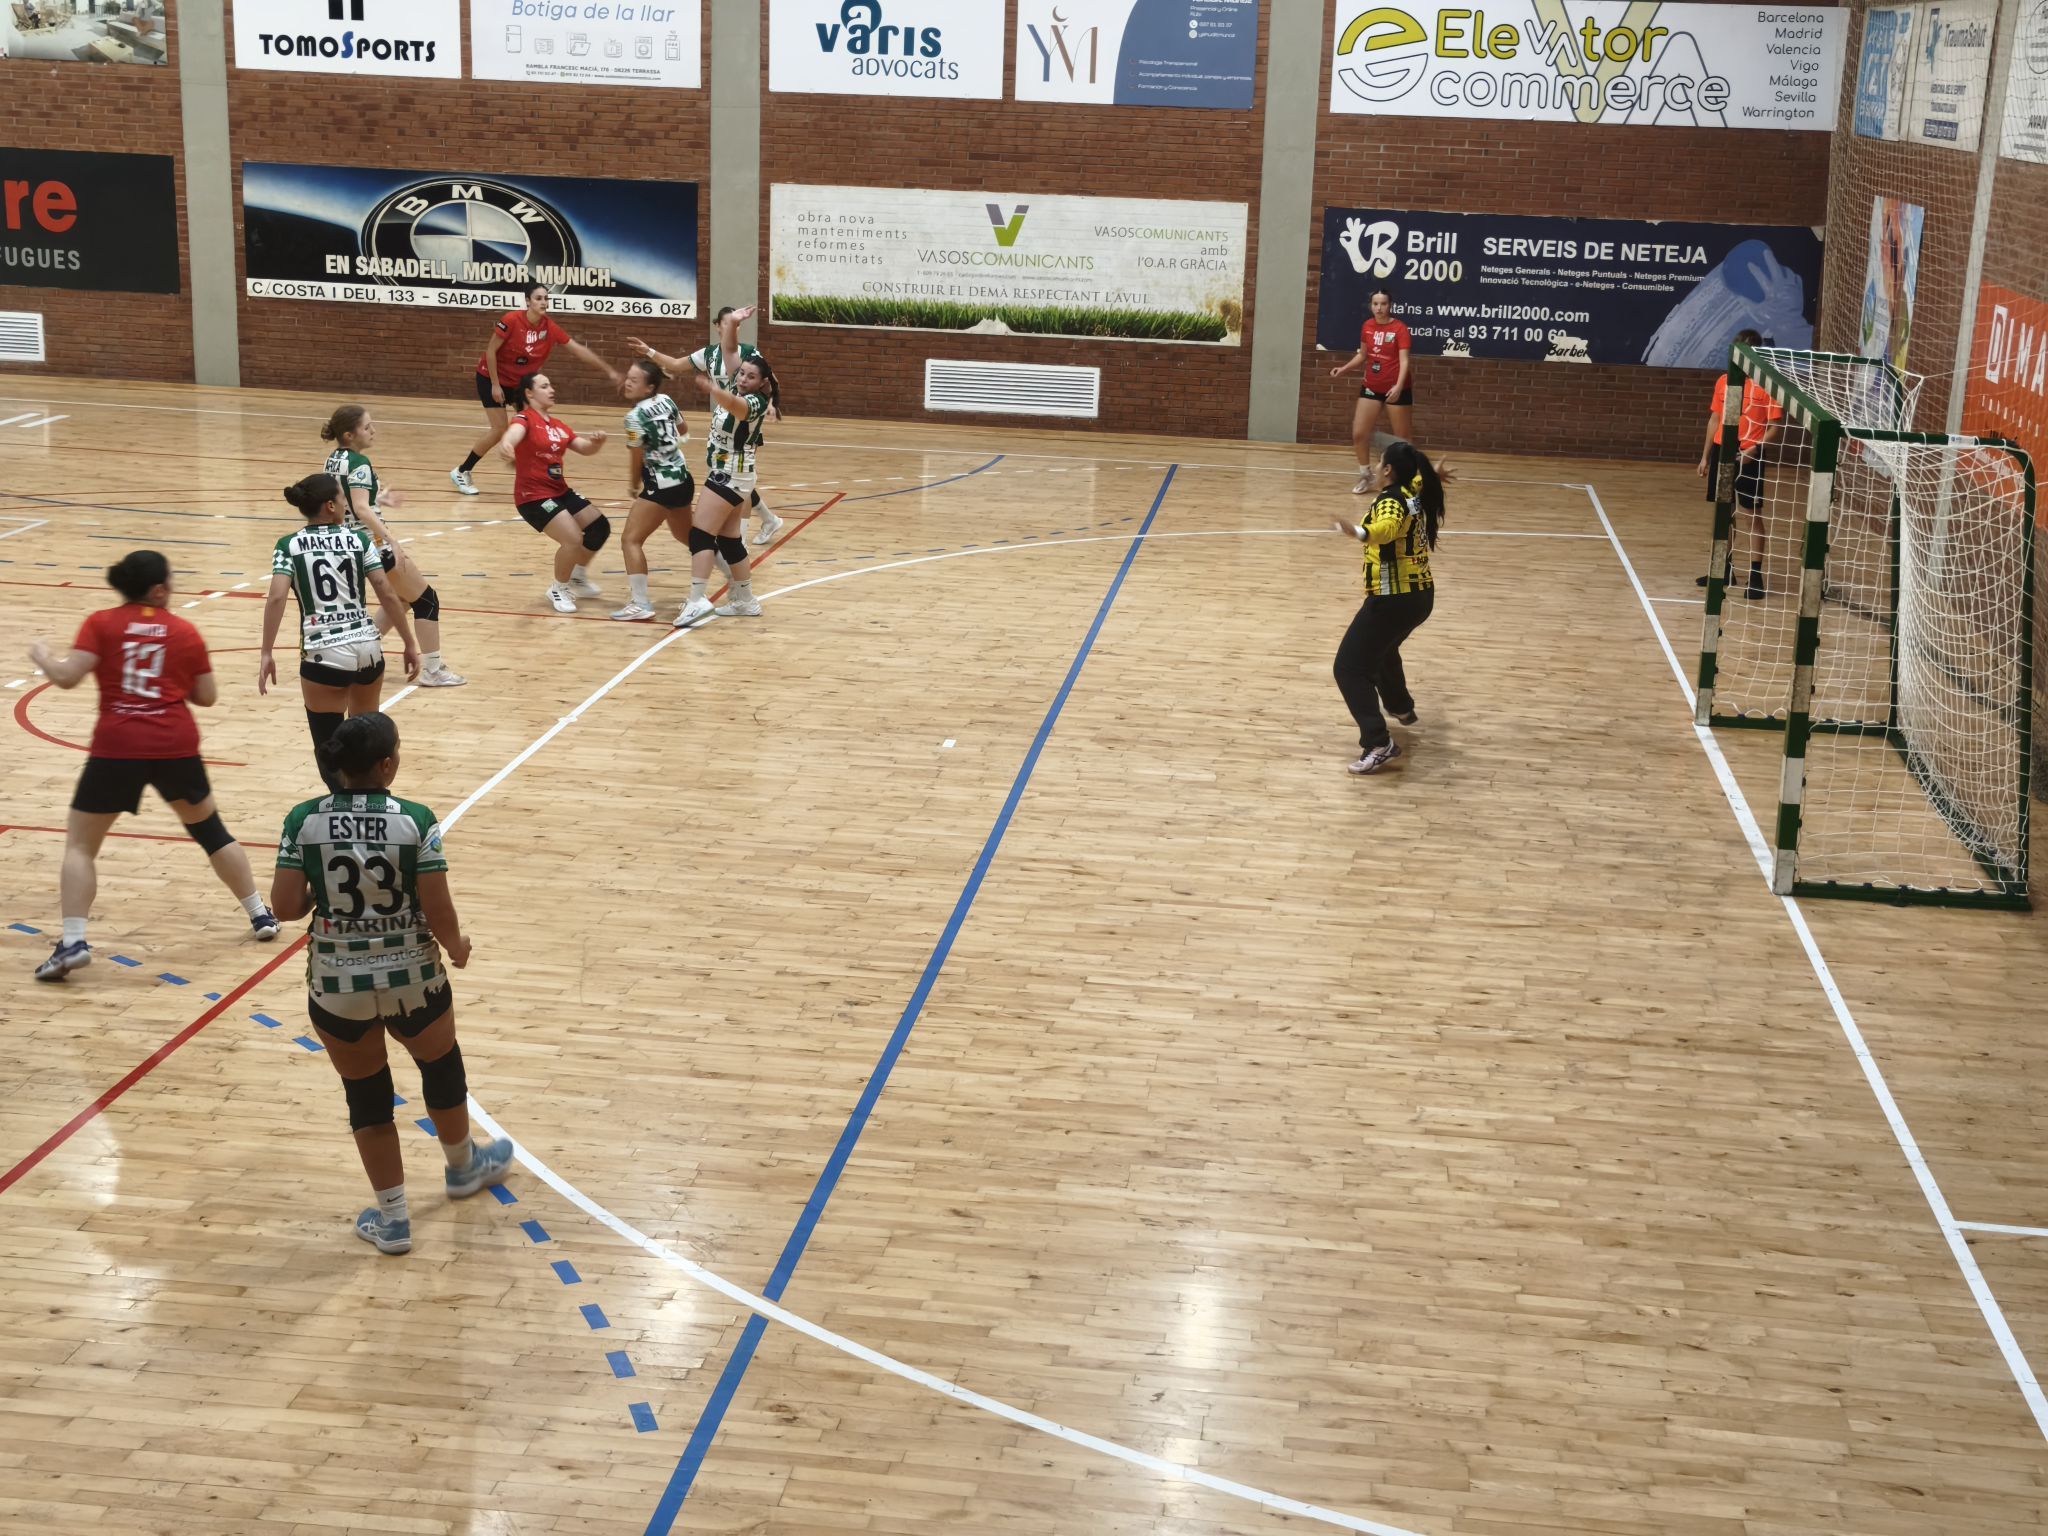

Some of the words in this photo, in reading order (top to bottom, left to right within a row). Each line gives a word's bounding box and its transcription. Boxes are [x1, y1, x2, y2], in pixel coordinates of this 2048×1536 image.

[511, 0, 577, 19] Botiga
[584, 4, 610, 20] de
[616, 4, 634, 21] la
[641, 4, 675, 22] llar
[1757, 12, 1824, 23] Barcelona
[1775, 28, 1823, 39] Madrid
[259, 31, 435, 62] TOMOSPORTS
[1766, 43, 1821, 55] Valencia
[852, 57, 959, 80] advocats
[1790, 60, 1819, 72] Vigo
[1769, 75, 1818, 89] Málaga
[1430, 70, 1731, 112] commerce
[1775, 91, 1816, 103] Sevilla
[1742, 106, 1814, 121] Warrington
[4, 180, 77, 233] re
[797, 210, 831, 223] obra
[839, 215, 875, 225] nova
[797, 226, 908, 240] manteniments
[1094, 226, 1229, 242] VASOSCOMUNICANTS
[797, 238, 866, 251] reformes
[1201, 245, 1228, 256] amb
[1407, 231, 1457, 254] Brill
[1483, 237, 1577, 259] SERVEIS
[1584, 242, 1614, 260] DE
[1621, 243, 1707, 264] NETEJA
[0, 246, 80, 270] UGUES
[797, 252, 883, 266] comunitats
[325, 254, 350, 275] EN
[355, 257, 457, 284] SABADELL,
[462, 261, 529, 283] MOTOR
[535, 264, 617, 288] MUNICH.
[1404, 259, 1462, 282] 2000
[1481, 265, 1513, 275] Neteges
[1515, 266, 1551, 276] Generals
[1557, 268, 1590, 278] Neteges
[1592, 270, 1627, 279] Puntuals
[1634, 272, 1667, 281] Neteges
[862, 281, 945, 296] CONSTRUIR
[950, 285, 963, 296] EL
[1013, 288, 1102, 302] RESPECTANT
[1480, 276, 1519, 285] Innovació
[1622, 282, 1675, 292] Consumibles
[344, 287, 381, 302] DEU,
[388, 289, 415, 302] 133
[438, 291, 521, 308] SABADELL
[547, 297, 576, 311] TEL.
[583, 299, 615, 313] 902
[621, 300, 653, 314] 366
[660, 302, 691, 316] 087
[1425, 306, 1433, 315] a
[1437, 304, 1590, 323] www.brill2000.com
[1454, 327, 1465, 338] al
[1468, 325, 1487, 339] 93
[1492, 326, 1518, 341] 711
[1524, 328, 1543, 342] 00
[297, 535, 344, 551] MARTA
[346, 535, 359, 550] R.
[312, 558, 357, 602] 61
[329, 816, 387, 841] ESTER
[327, 855, 404, 919] 33
